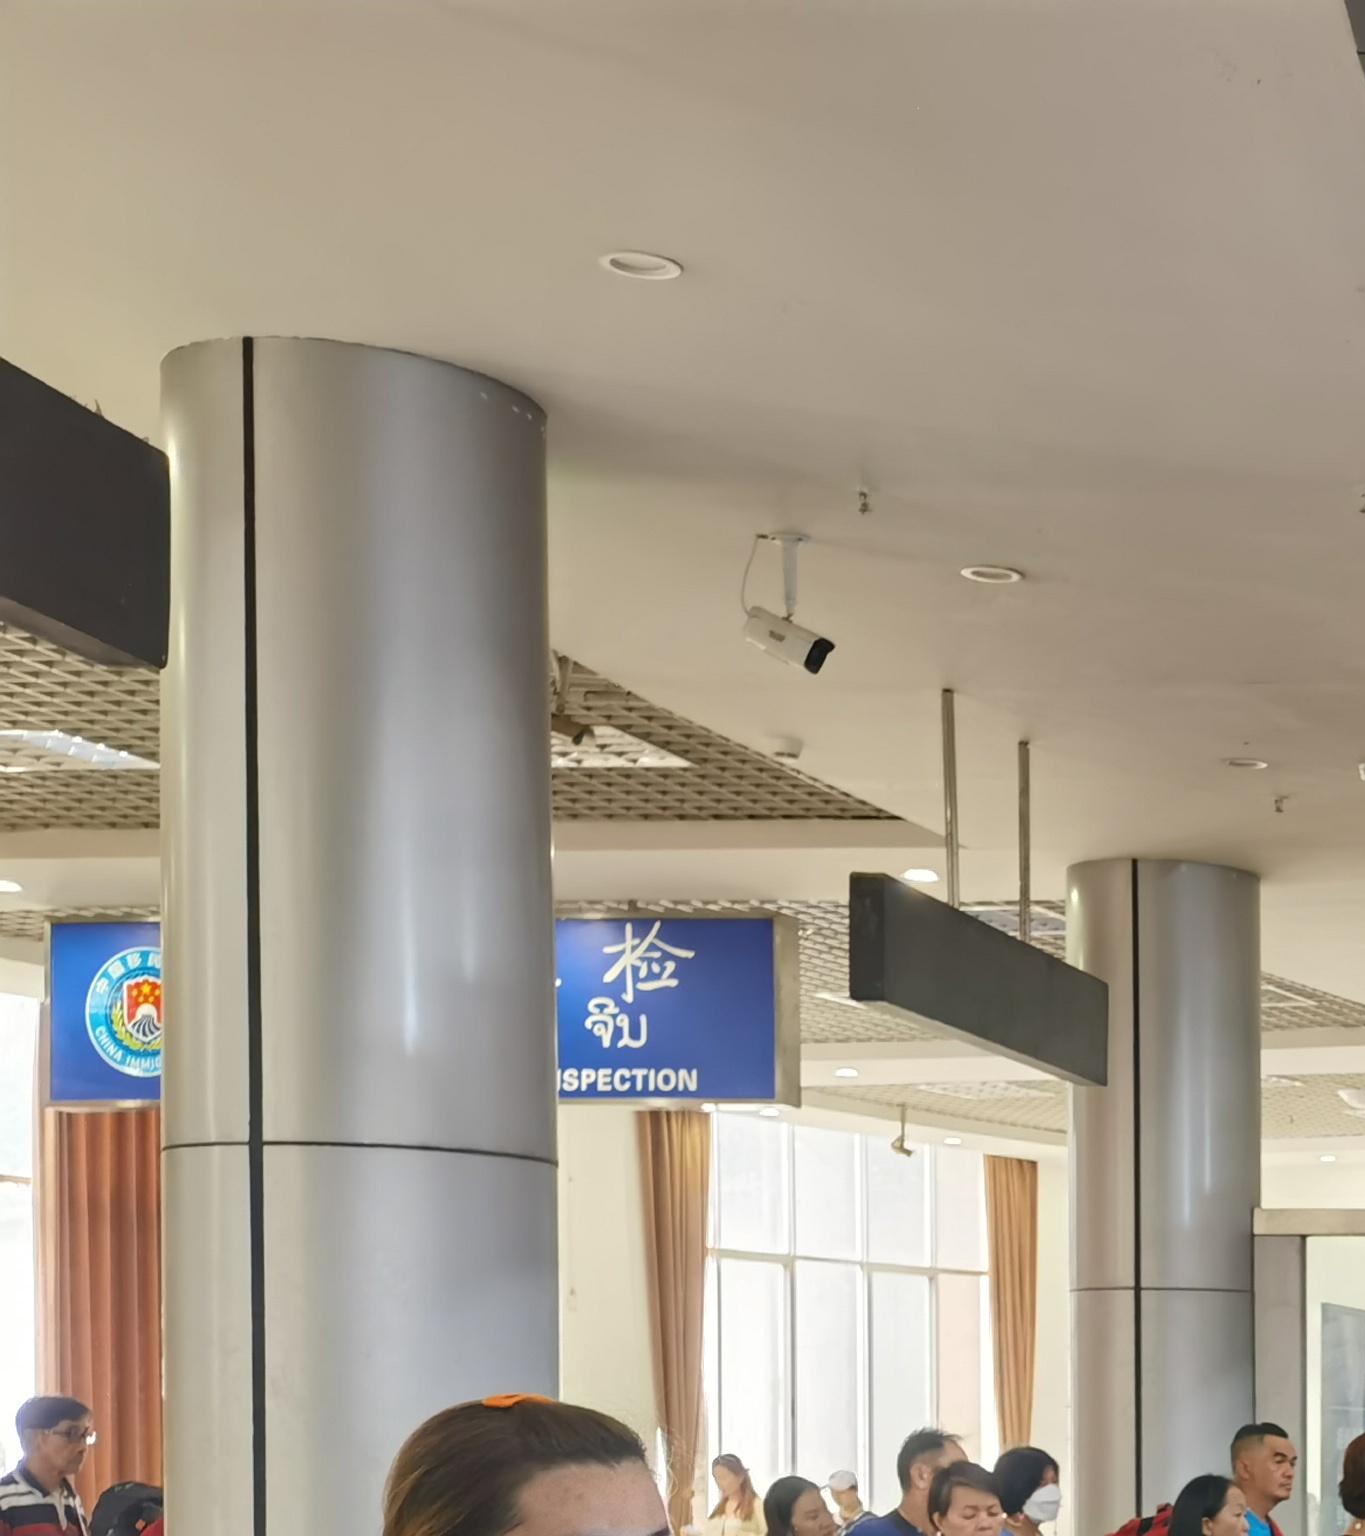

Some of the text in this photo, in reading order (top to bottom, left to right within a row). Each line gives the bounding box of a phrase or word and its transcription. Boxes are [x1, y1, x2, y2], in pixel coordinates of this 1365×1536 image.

[555, 920, 696, 1004] 检
[95, 1028, 123, 1062] CHINA
[558, 1067, 698, 1092] SPECTION
